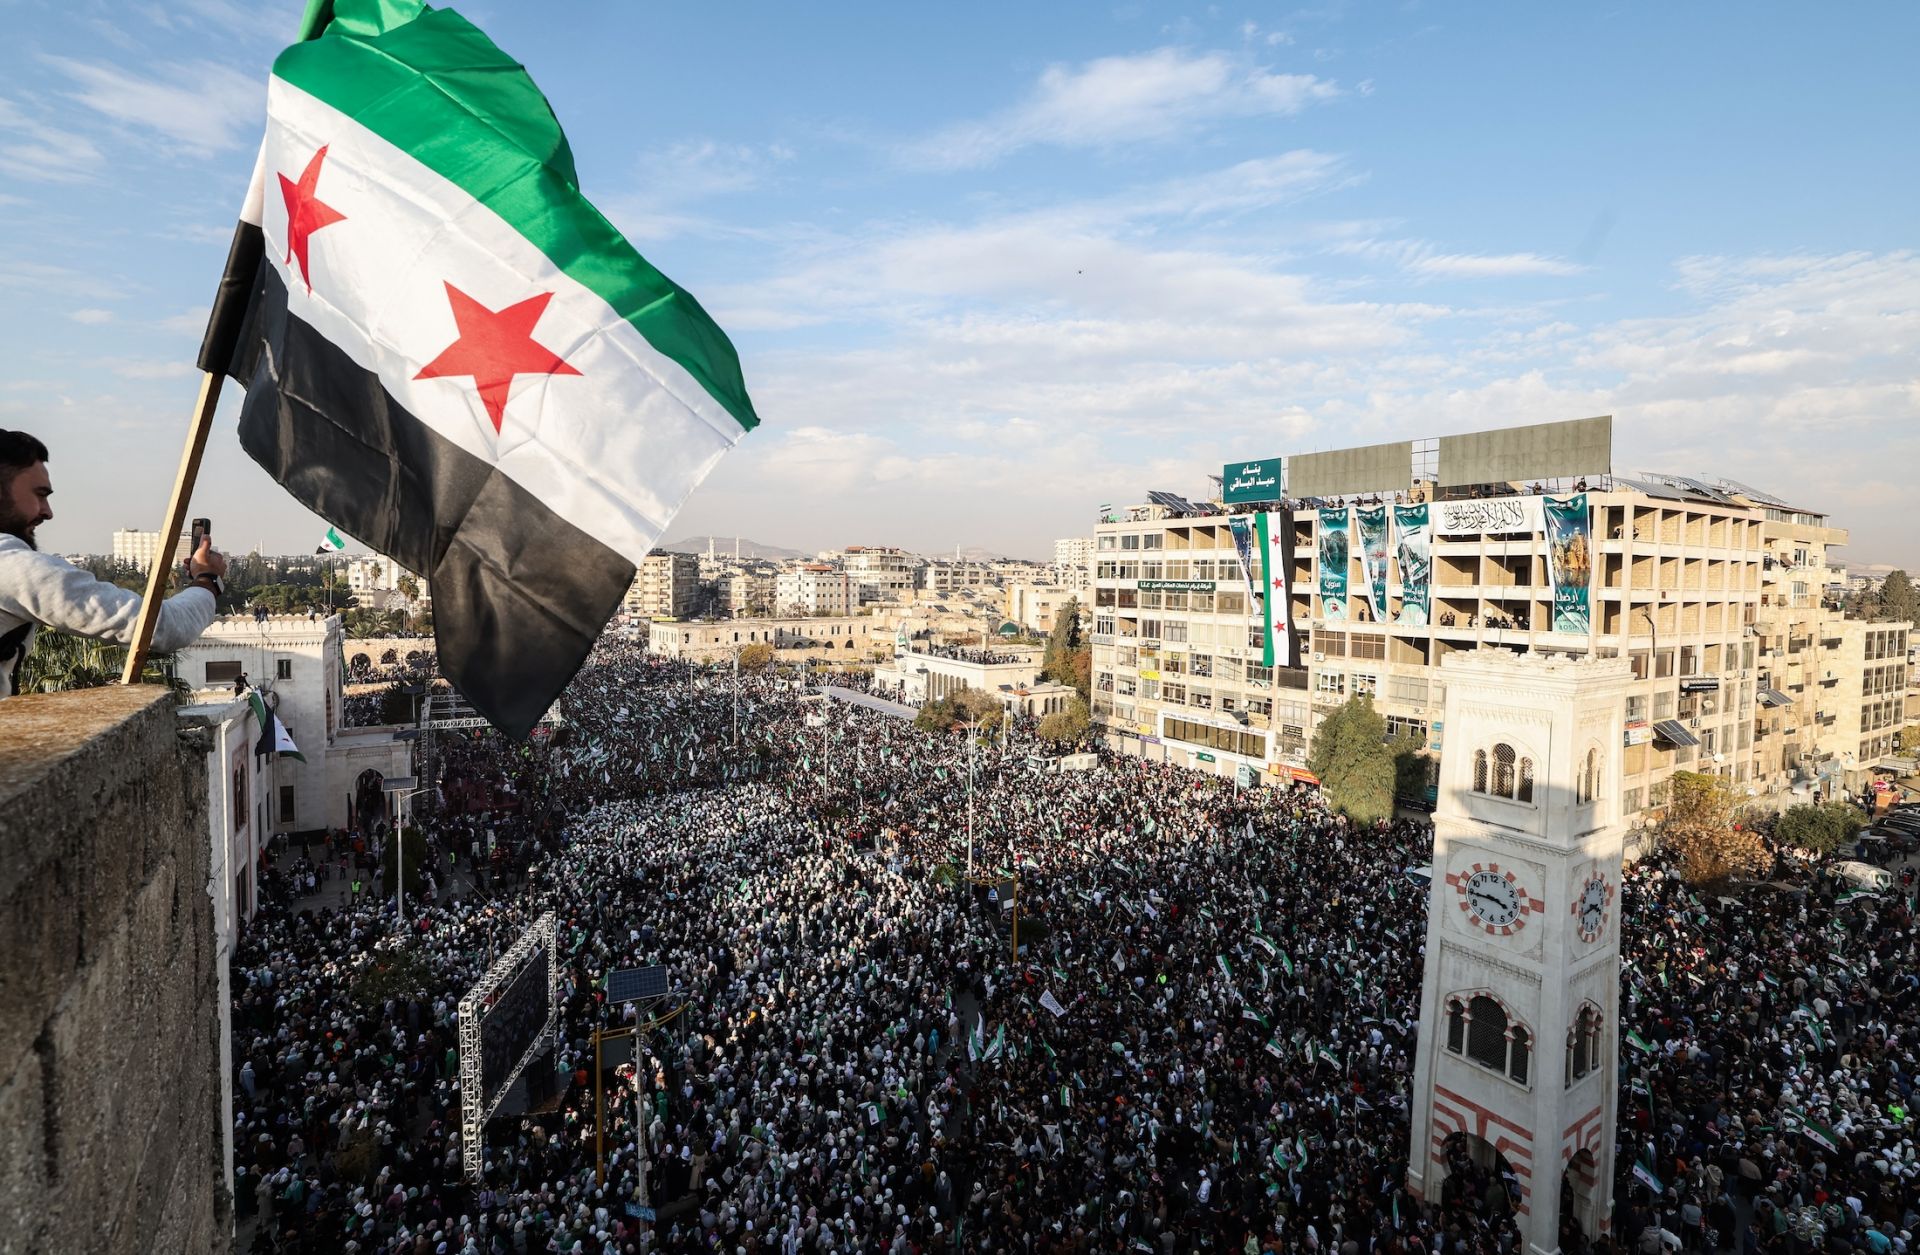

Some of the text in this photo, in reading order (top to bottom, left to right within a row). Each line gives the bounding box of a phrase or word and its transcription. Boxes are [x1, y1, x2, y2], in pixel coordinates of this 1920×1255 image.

[1242, 463, 1261, 476] بناء
[1256, 477, 1275, 488] عبد
[1324, 579, 1341, 589] سوريا
[1480, 874, 1487, 883] 11
[1490, 875, 1499, 884] 12
[1473, 879, 1480, 888] 10
[1509, 890, 1515, 898] 2
[1472, 899, 1477, 907] 8
[1512, 901, 1517, 909] 3
[1489, 914, 1494, 922] 6
[1508, 910, 1513, 918] 4
[1500, 915, 1505, 923] 5
